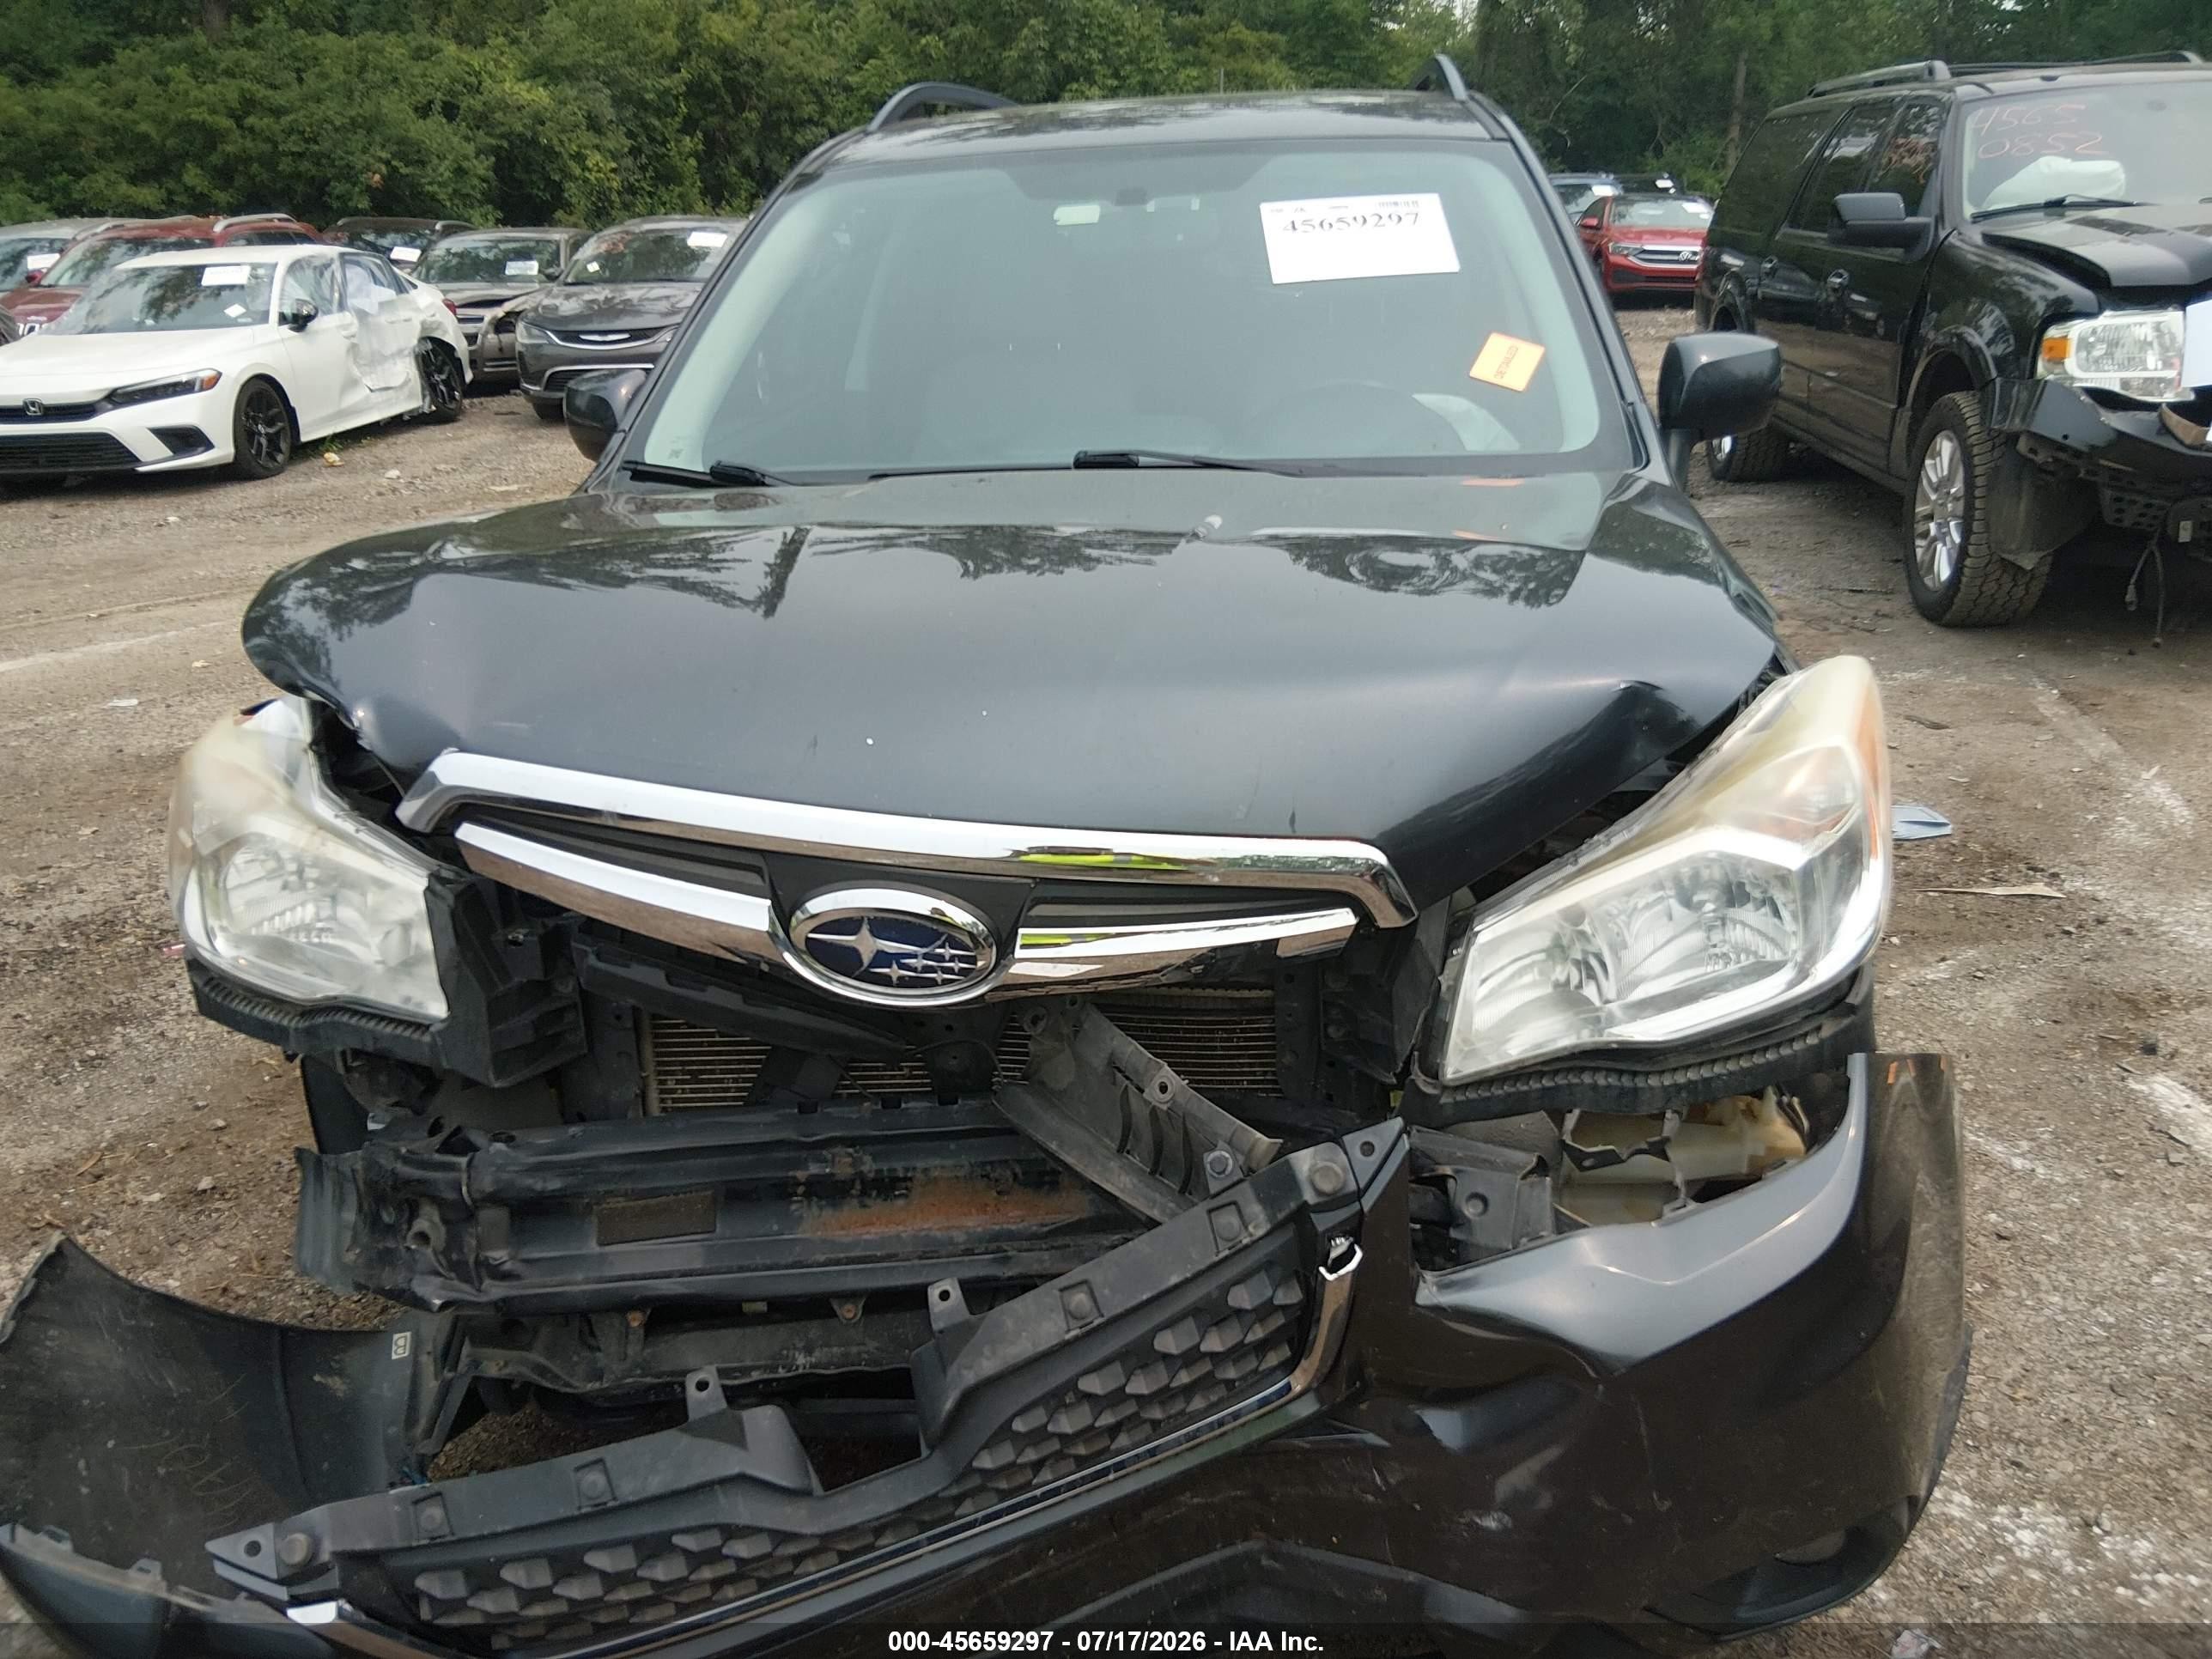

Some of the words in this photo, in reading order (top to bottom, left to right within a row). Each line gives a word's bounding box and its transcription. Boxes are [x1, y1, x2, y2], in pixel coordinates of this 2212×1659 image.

[1972, 104, 2087, 137] 4565
[1978, 131, 2110, 159] 0852
[1283, 211, 1419, 233] 45659297
